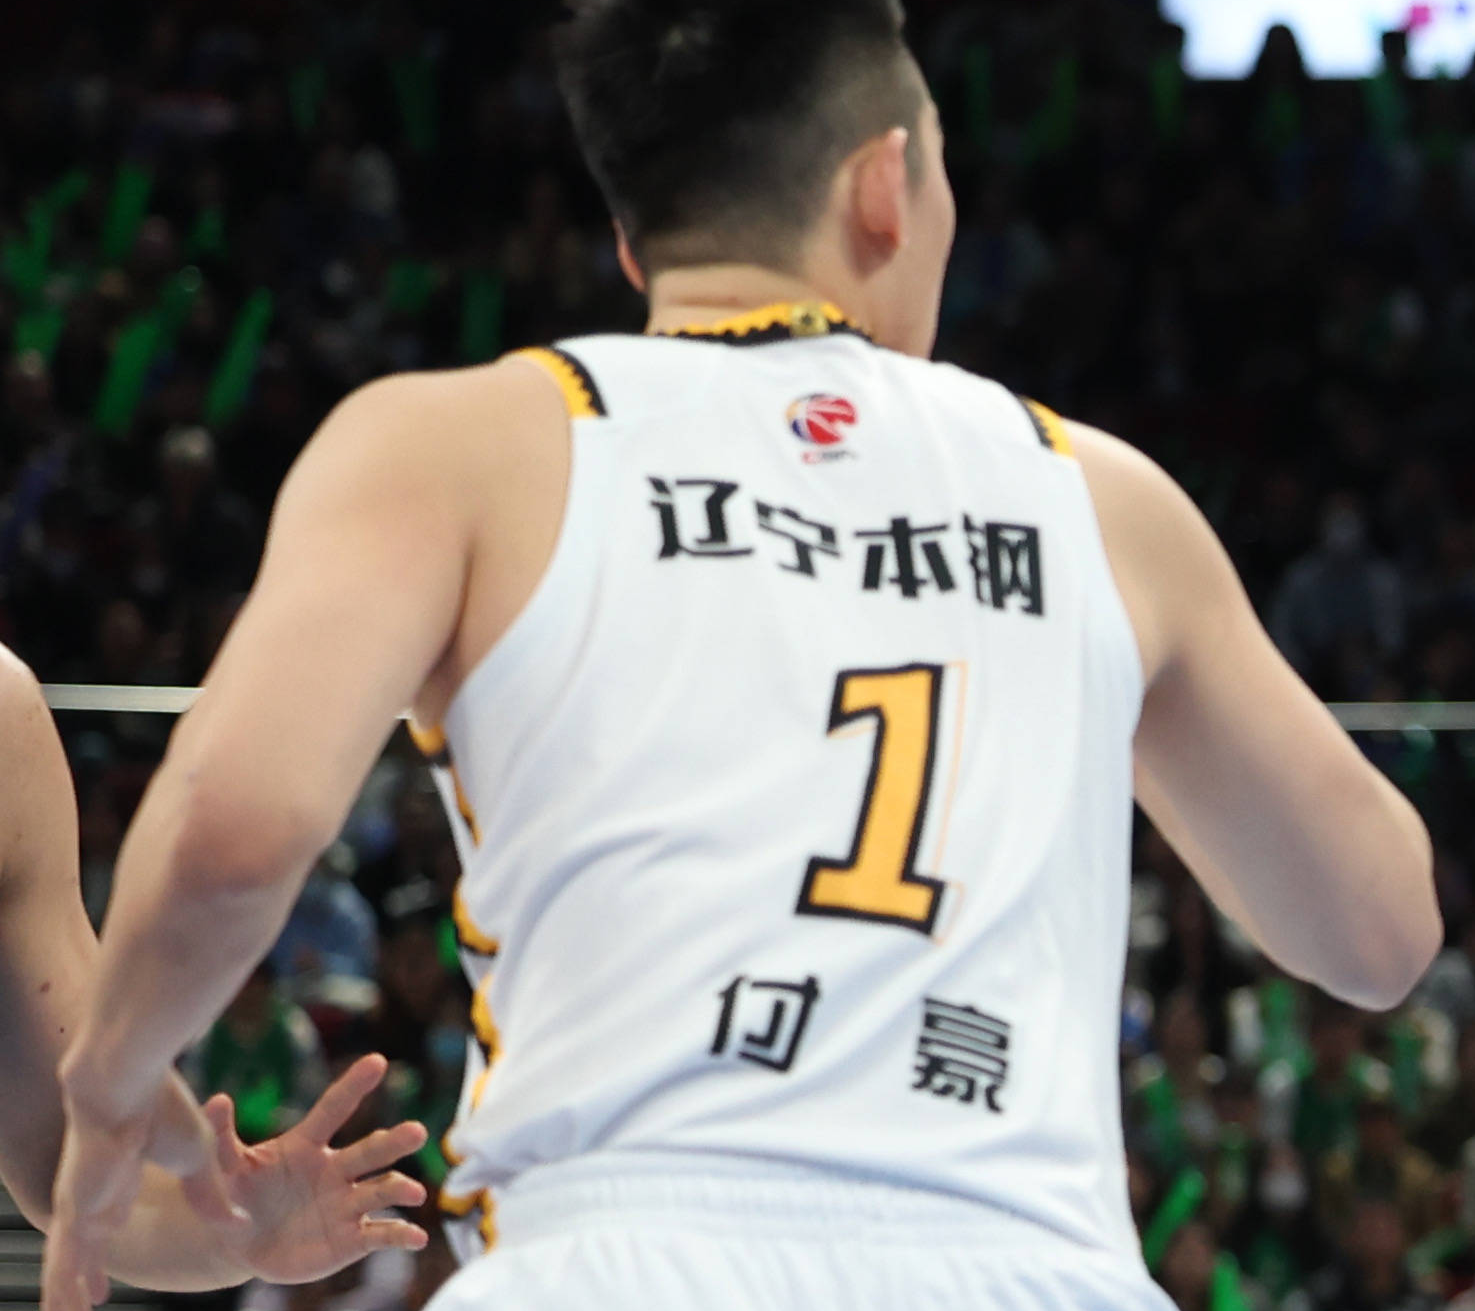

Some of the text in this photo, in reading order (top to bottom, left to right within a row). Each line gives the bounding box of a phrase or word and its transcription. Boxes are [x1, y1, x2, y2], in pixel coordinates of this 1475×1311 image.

[647, 474, 1045, 618] 辽宁本钢
[794, 663, 948, 935] 1
